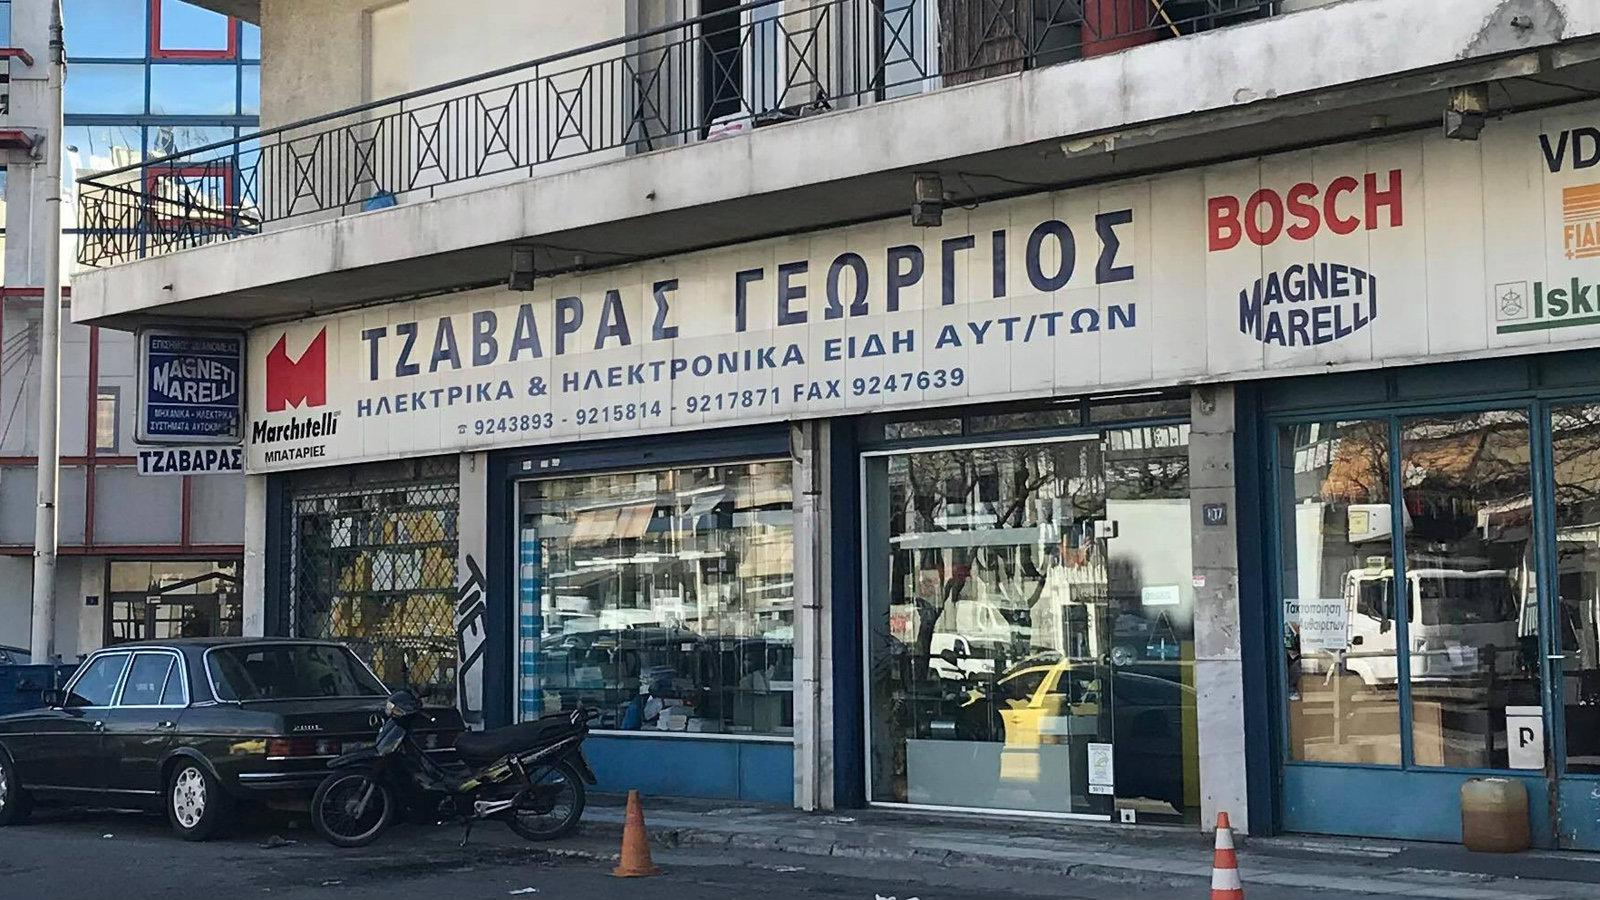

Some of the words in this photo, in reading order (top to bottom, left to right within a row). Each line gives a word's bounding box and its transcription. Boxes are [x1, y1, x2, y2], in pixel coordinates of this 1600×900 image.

[1208, 169, 1403, 252] BOSCH
[1564, 222, 1600, 249] FIA
[361, 278, 679, 382] ΤΖΑΒΑΡΑΣ
[735, 208, 1134, 332] ΓΕΩΡΓΙΟΣ
[1239, 263, 1376, 321] MAGNETI
[1239, 289, 1376, 346] MARELLI
[153, 358, 236, 388] MAGNETI
[356, 380, 513, 418] ΗΛΕΚΤΡΙΚΑ
[528, 376, 547, 397] &
[562, 344, 804, 393] ΗΛΕΚΤΡΟΝΙΚΑ
[824, 329, 914, 361] ΕΙΔΗ
[935, 303, 1136, 350] ΑΥΤ/ΤΩΝ
[153, 373, 236, 403] MARELLI
[474, 412, 553, 436] 9243893
[576, 399, 662, 426] 9215814
[686, 383, 780, 414] 9217871
[793, 378, 841, 402] FAX
[852, 366, 965, 397] 9247639
[252, 412, 337, 444] Marchitelli
[140, 449, 242, 473] ΤΖΑΒΑΡΑΣ
[265, 445, 325, 462] ΜΠΑΤΑΡΙΕΣ
